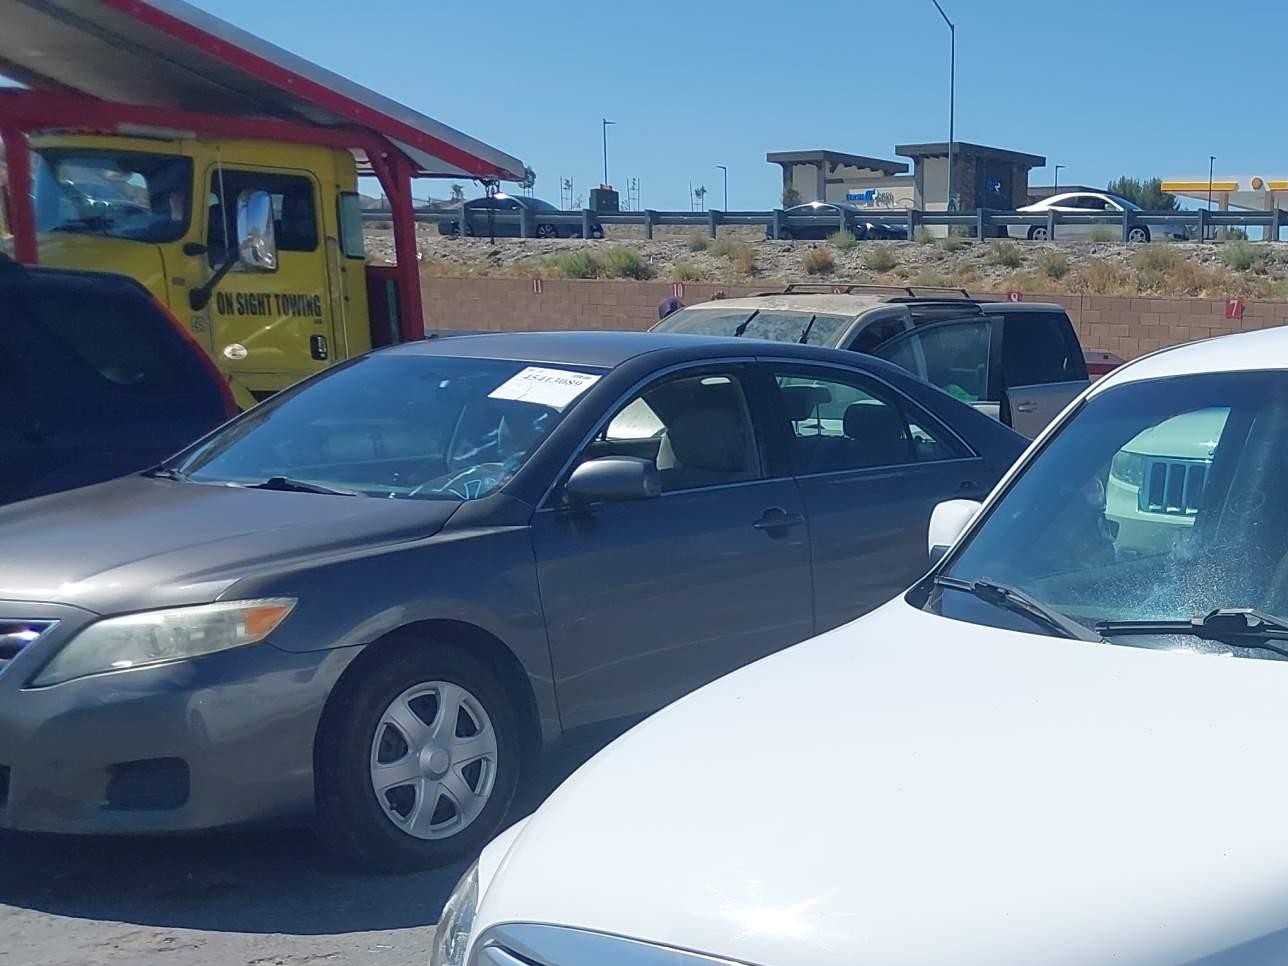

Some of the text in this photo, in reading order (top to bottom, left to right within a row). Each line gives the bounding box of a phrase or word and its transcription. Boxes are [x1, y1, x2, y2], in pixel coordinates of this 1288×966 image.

[673, 283, 683, 298] 10
[216, 292, 322, 318] ON SIGHT TOWING
[1229, 299, 1239, 318] 7
